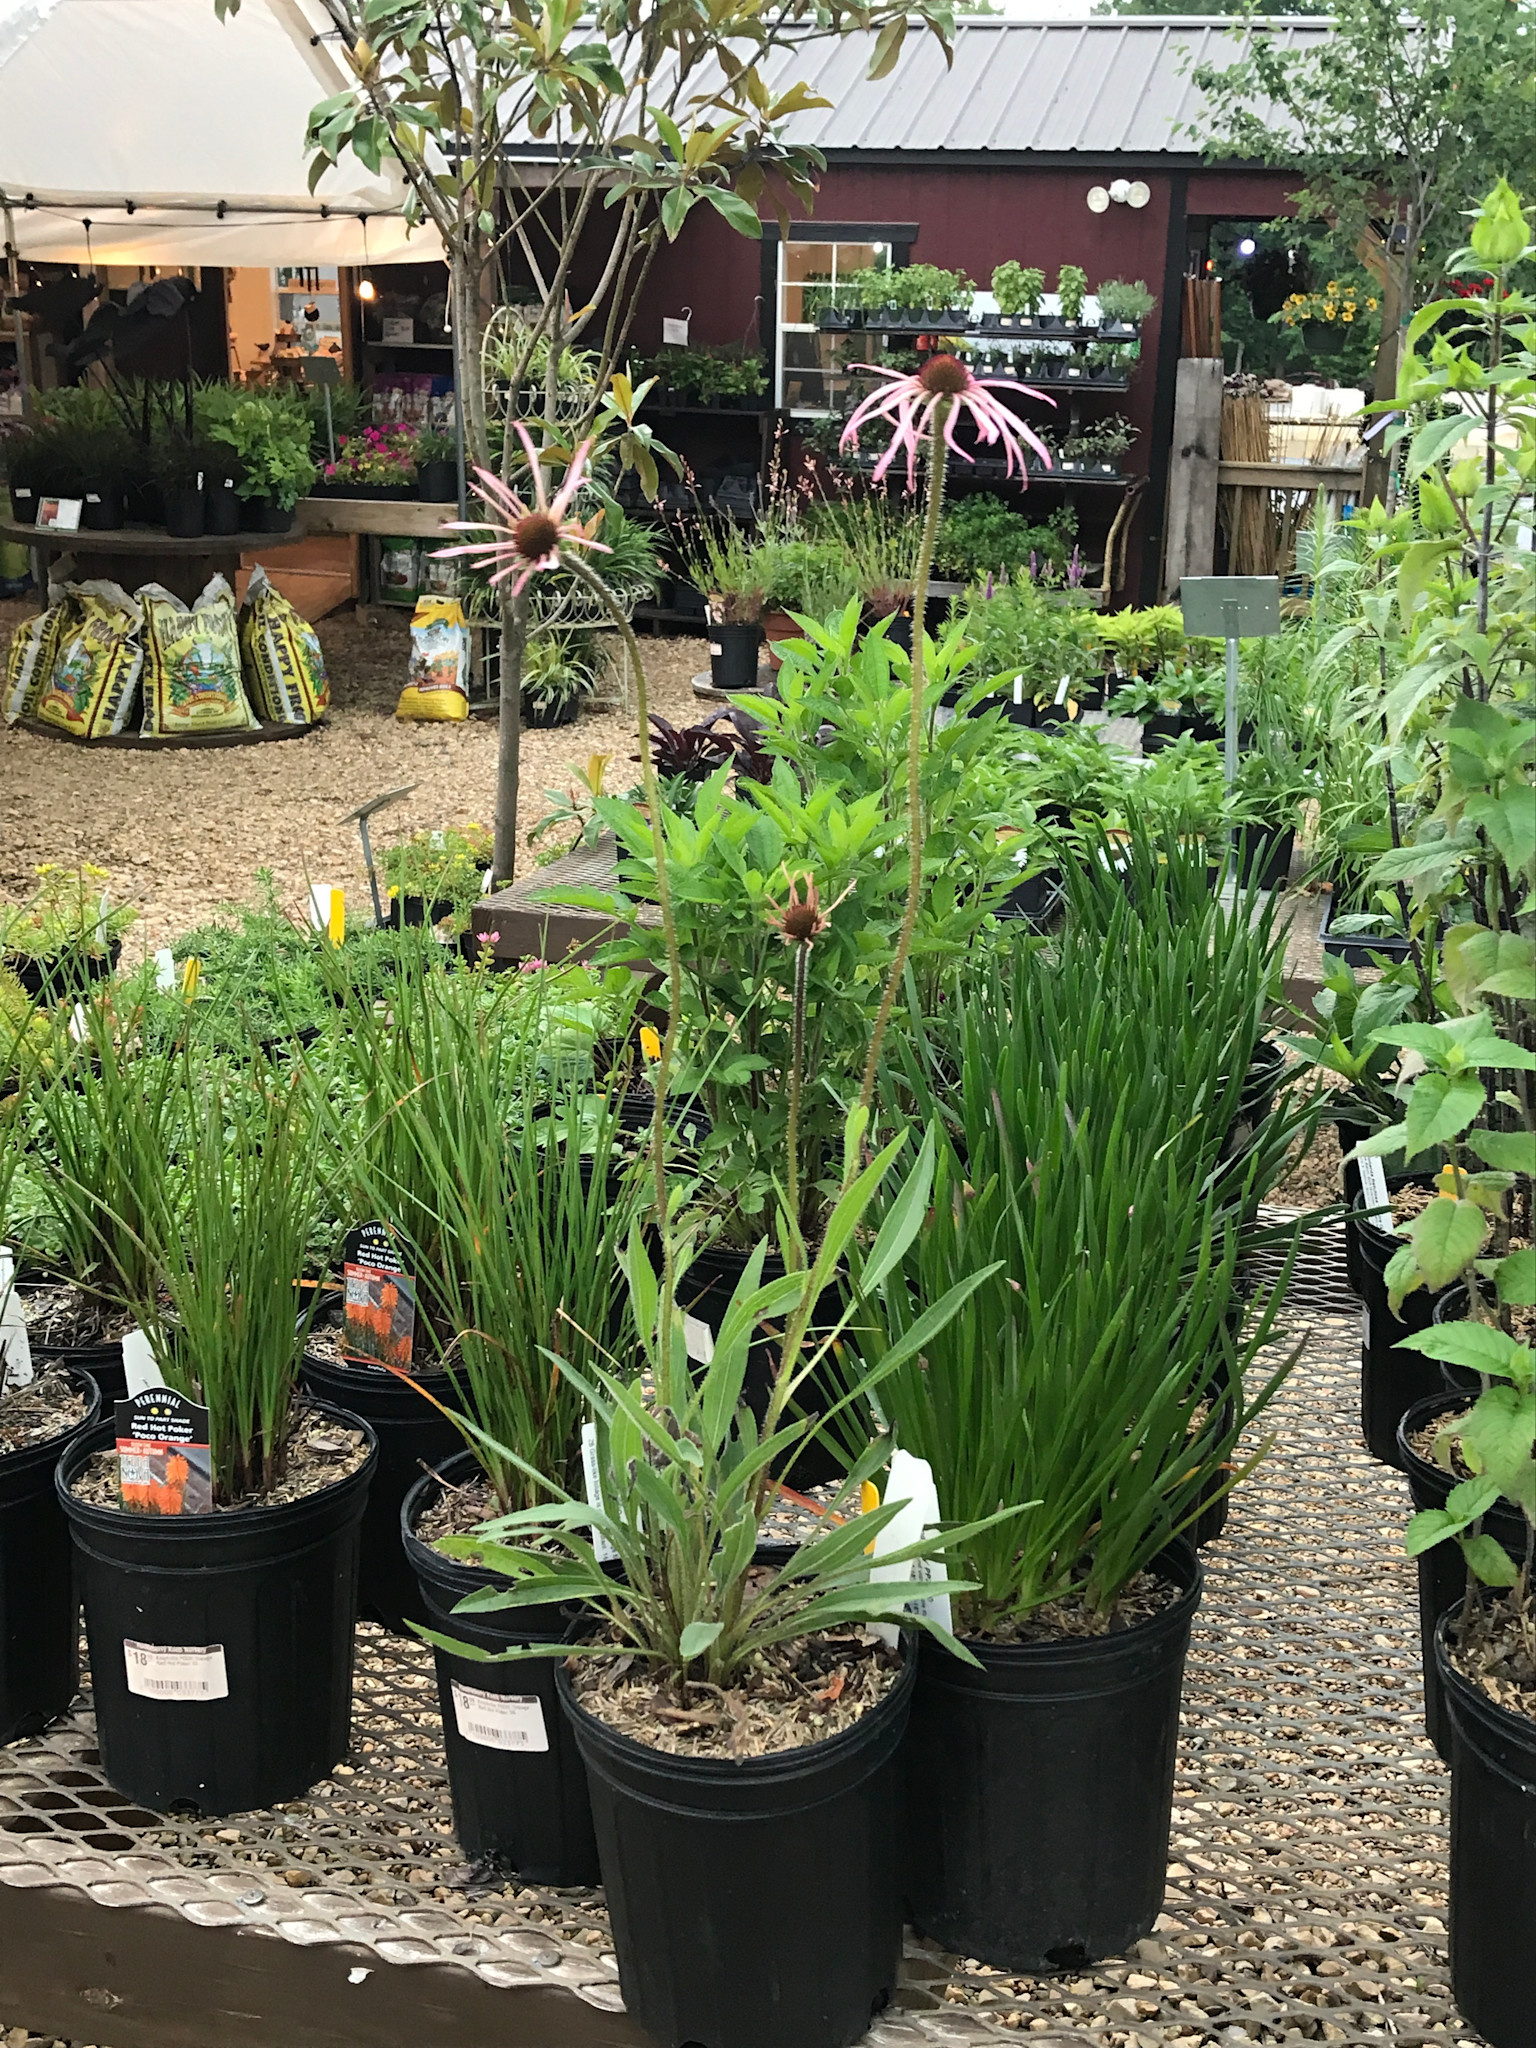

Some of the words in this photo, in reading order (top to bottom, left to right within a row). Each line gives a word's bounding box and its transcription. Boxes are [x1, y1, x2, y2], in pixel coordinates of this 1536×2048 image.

[268, 617, 294, 677] HAPPY
[103, 657, 132, 721] HAPPY
[357, 1250, 370, 1258] Red
[371, 1252, 383, 1261] Hot
[134, 1394, 182, 1408] PERENNIAL
[131, 1422, 148, 1430] Red
[150, 1424, 166, 1432] Hot
[168, 1425, 194, 1434] Poker
